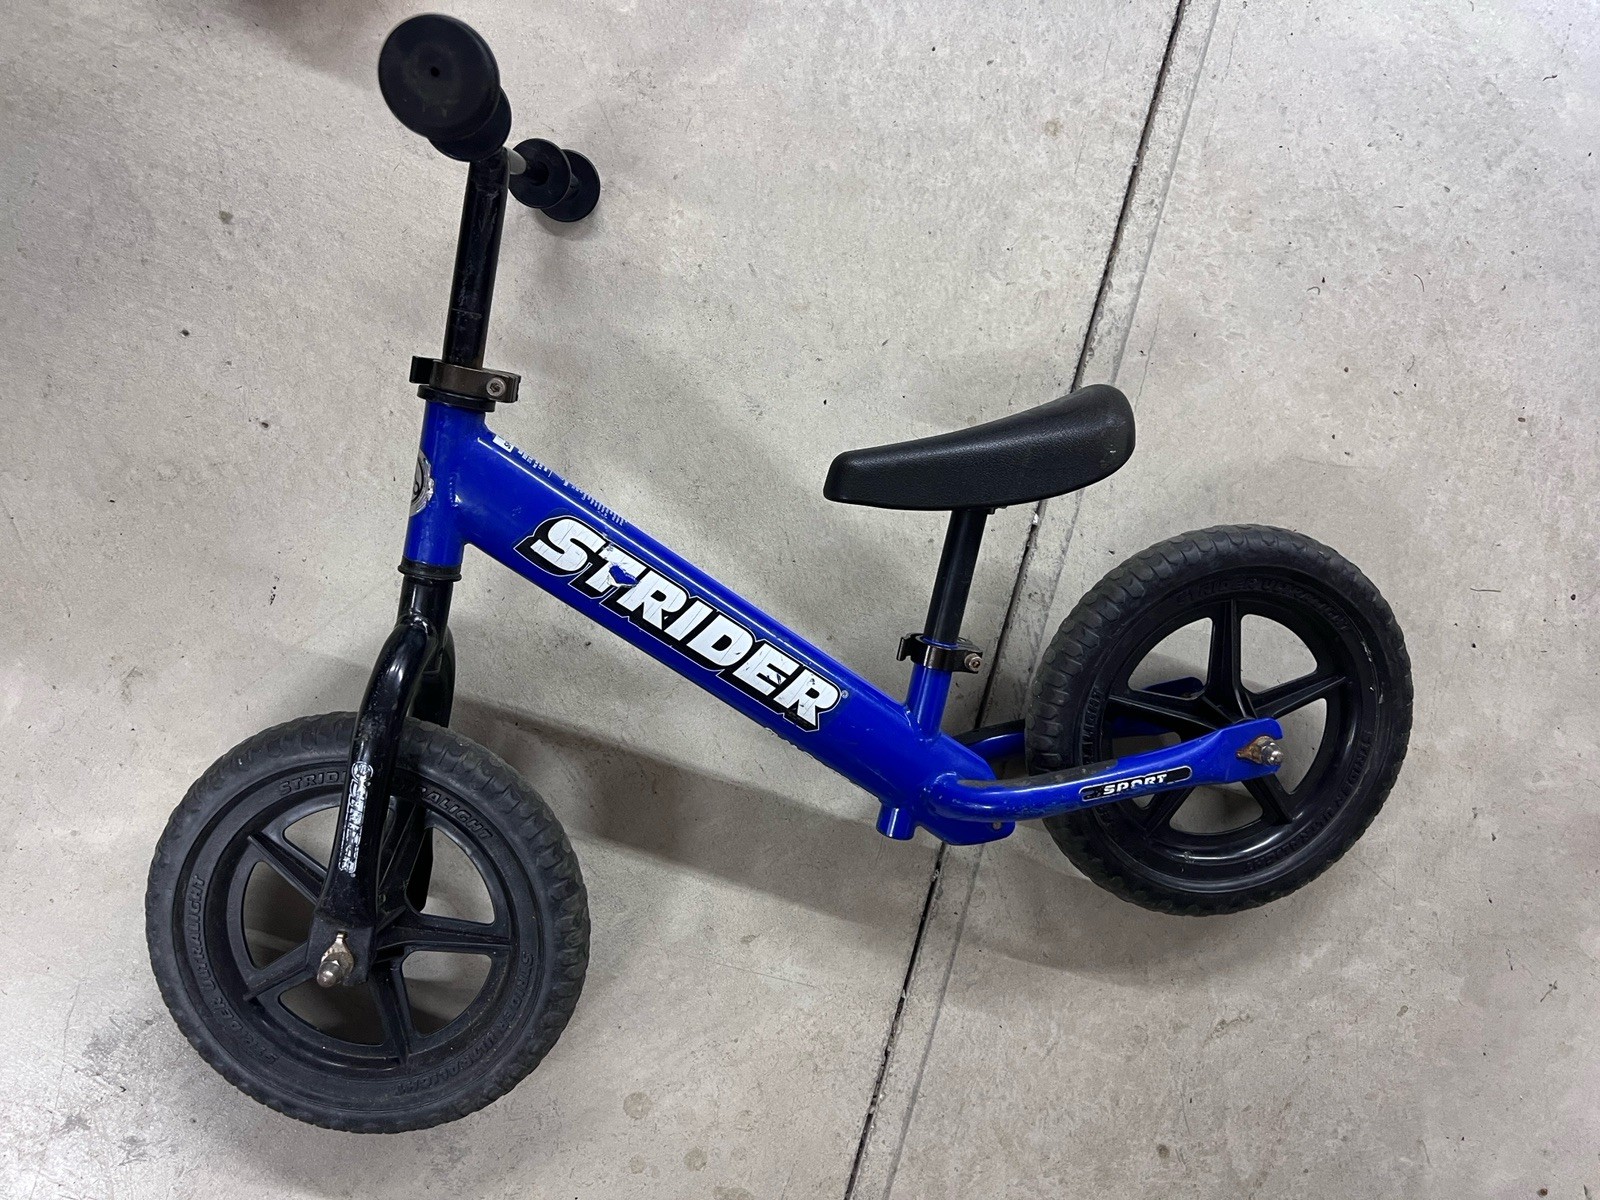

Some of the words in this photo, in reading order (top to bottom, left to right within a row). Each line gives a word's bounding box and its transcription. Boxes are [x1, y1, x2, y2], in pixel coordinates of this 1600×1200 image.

[528, 516, 841, 729] STRIDER
[278, 769, 347, 797] STRID
[1102, 772, 1169, 796] SPORT
